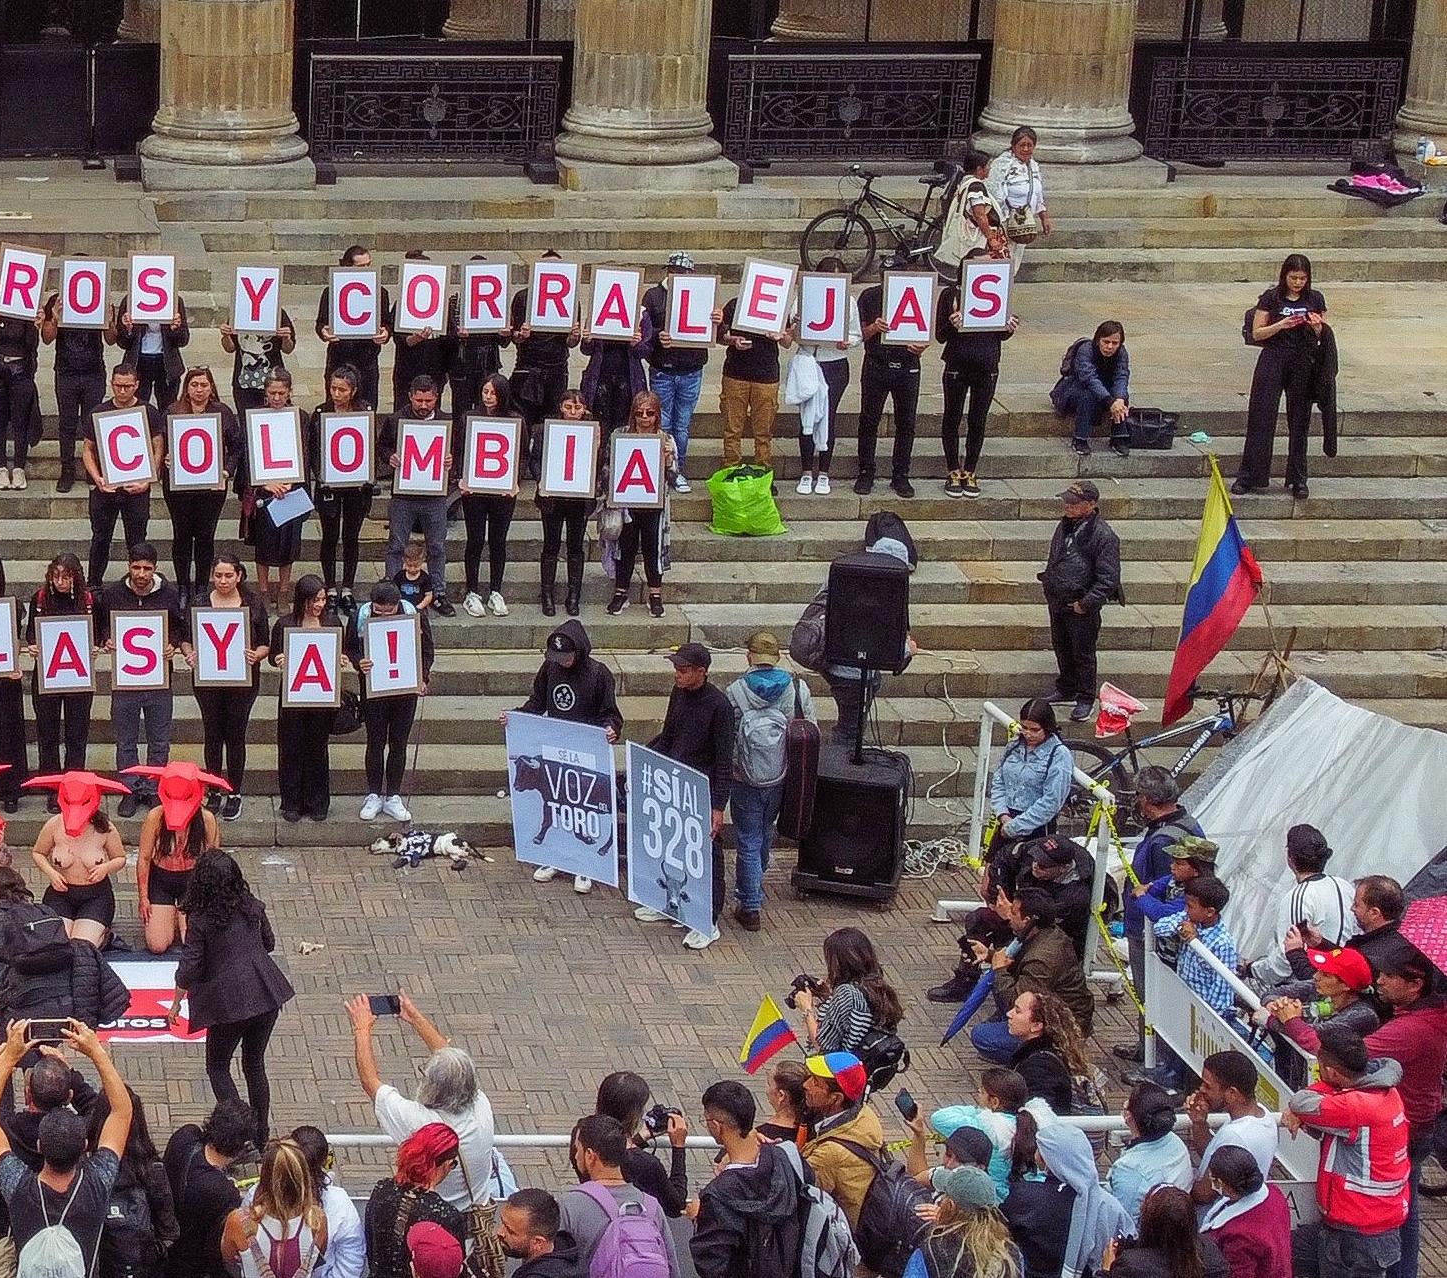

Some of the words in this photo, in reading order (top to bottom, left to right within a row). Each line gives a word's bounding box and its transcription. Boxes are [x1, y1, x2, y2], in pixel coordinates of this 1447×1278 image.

[242, 277, 274, 322] Y
[338, 273, 1003, 335] CORRALEJAS
[108, 424, 655, 493] COLOMBIA
[544, 764, 598, 809] VOZ
[546, 801, 601, 838] TORO
[642, 797, 704, 880] 328
